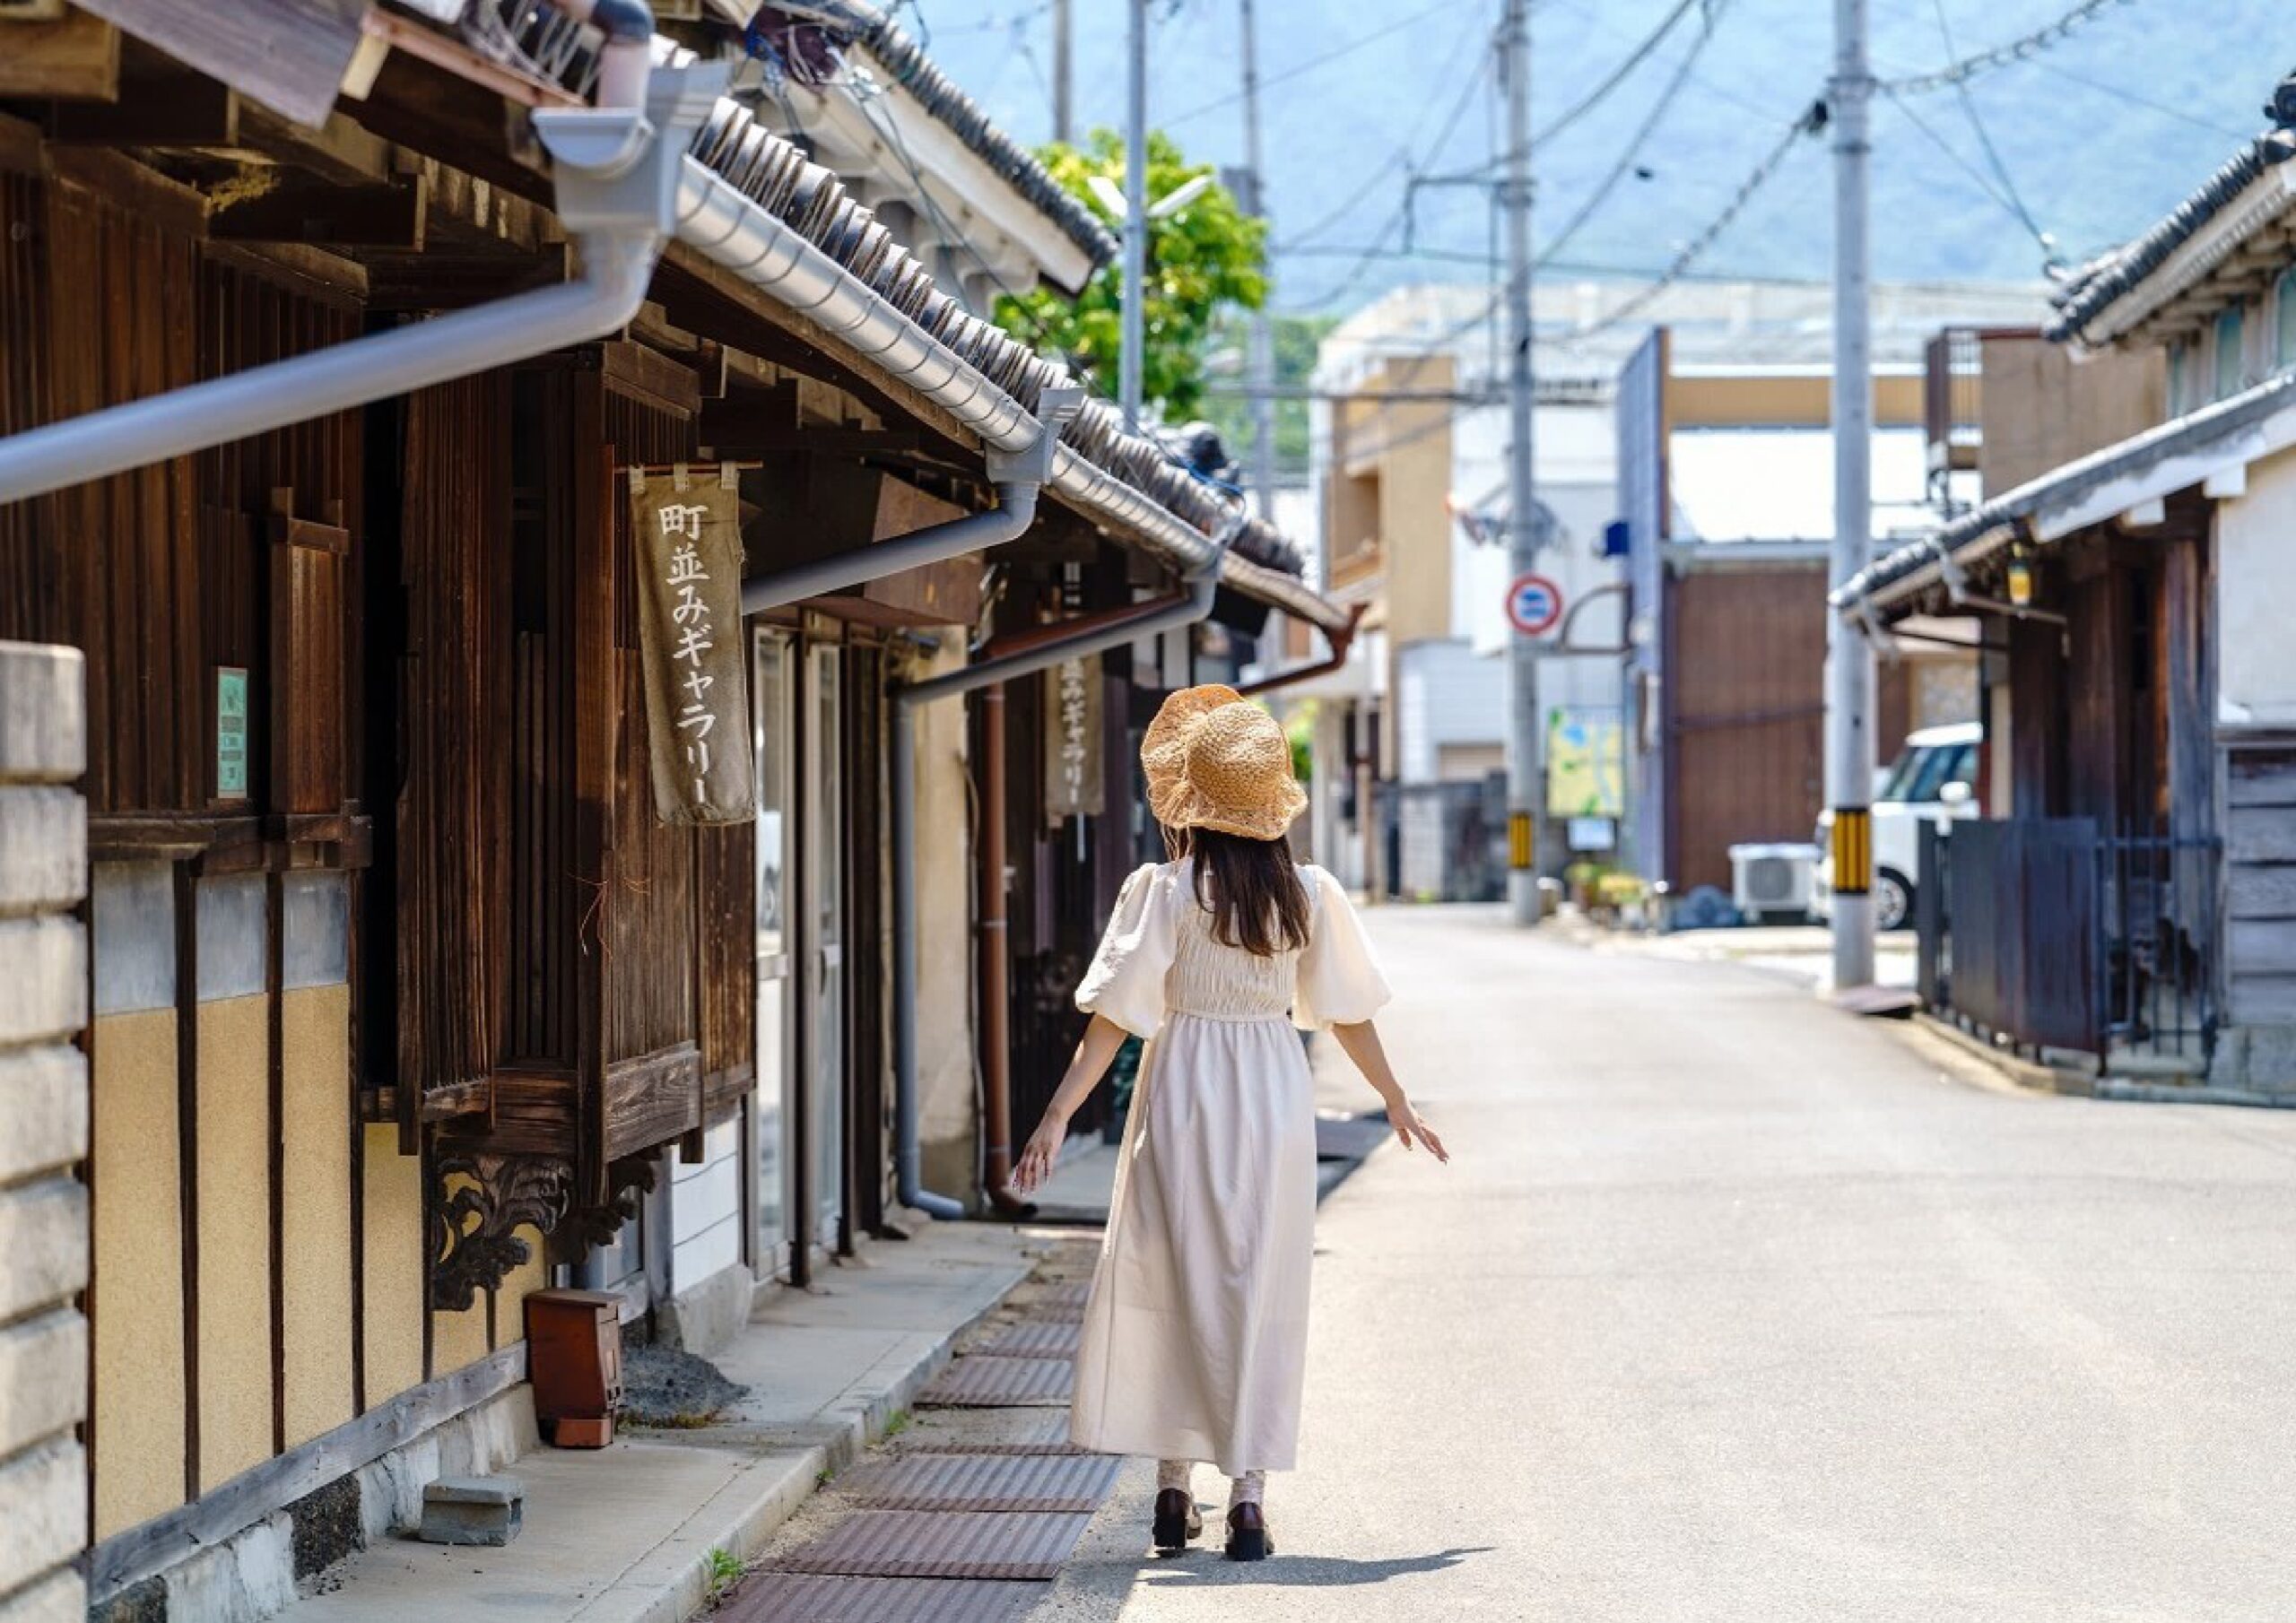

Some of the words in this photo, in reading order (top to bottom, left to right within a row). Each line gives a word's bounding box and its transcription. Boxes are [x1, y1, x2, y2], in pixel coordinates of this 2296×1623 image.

[658, 504, 716, 803] 町並みギャラリー
